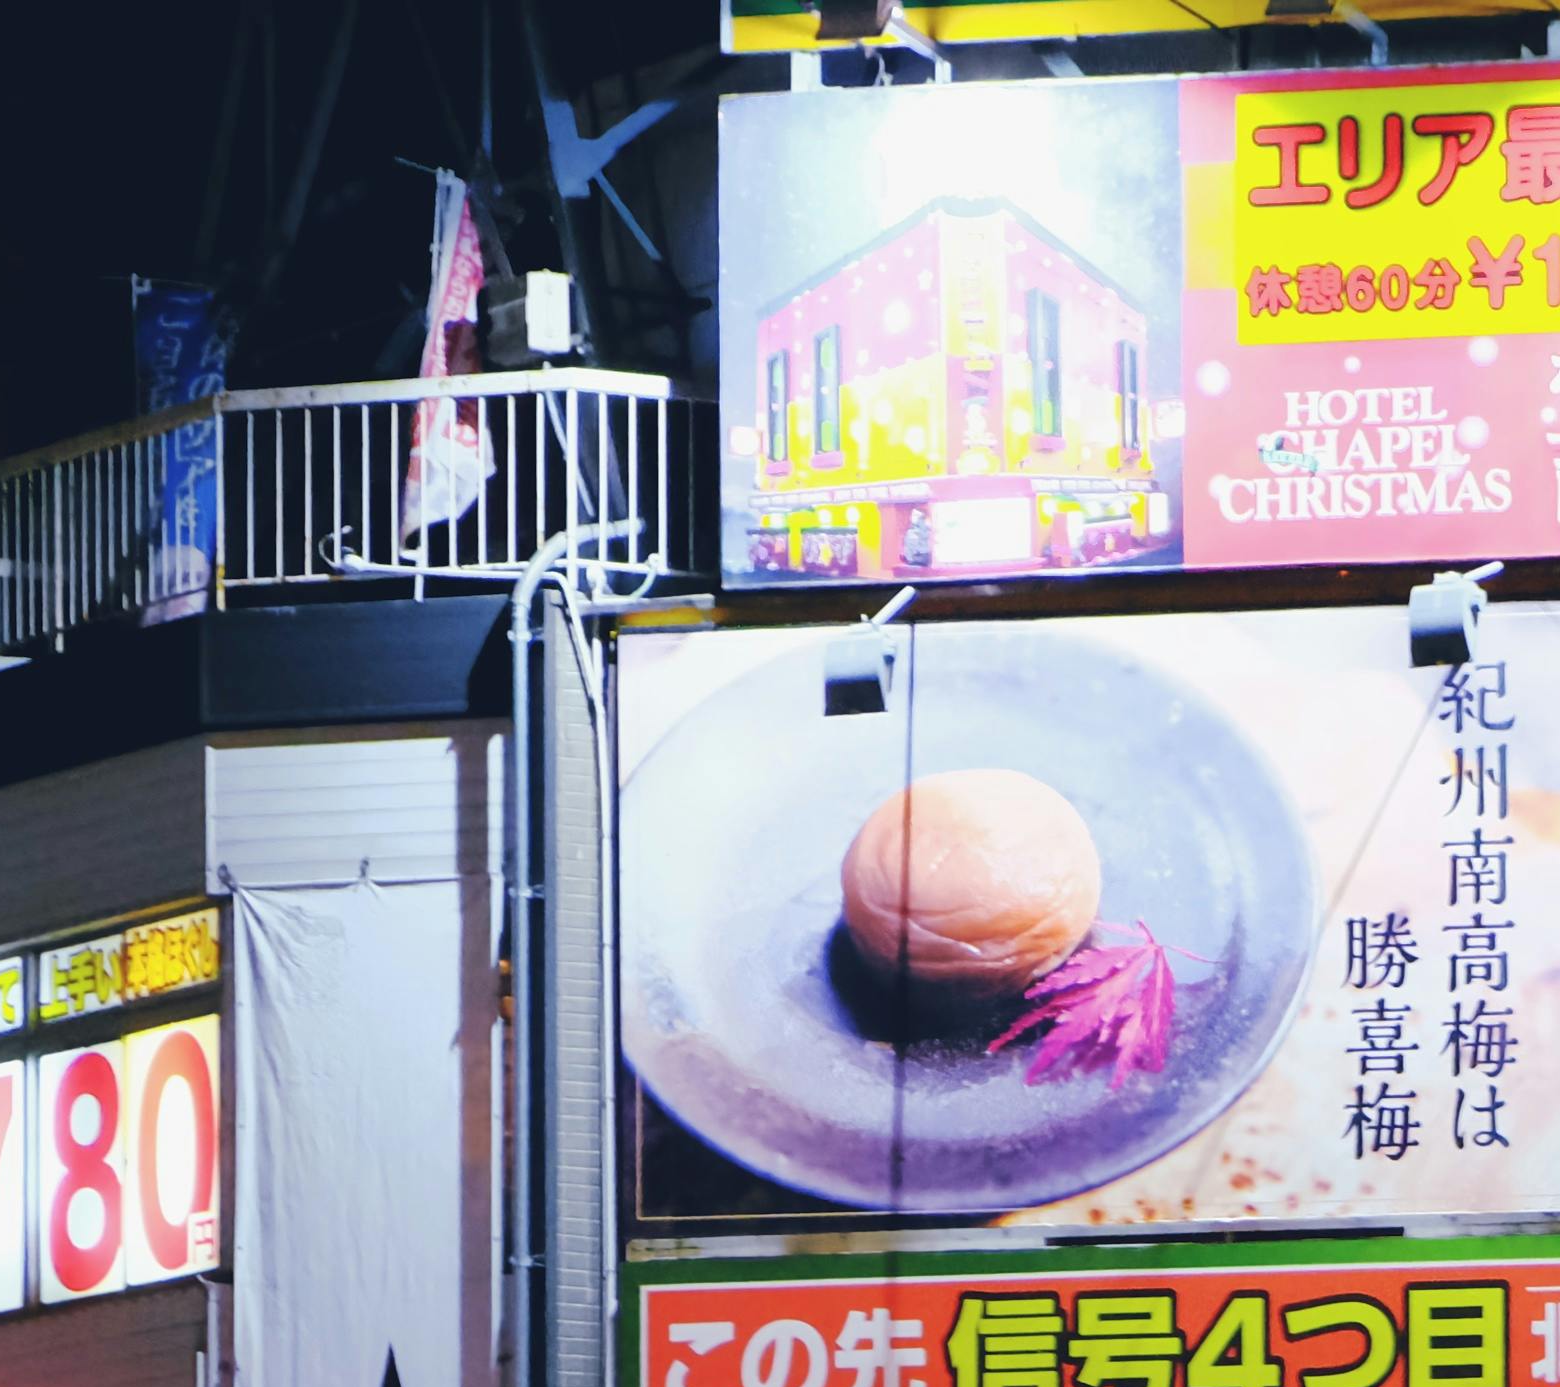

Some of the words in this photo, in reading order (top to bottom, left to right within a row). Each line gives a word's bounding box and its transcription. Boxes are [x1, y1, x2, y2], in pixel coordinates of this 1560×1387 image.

[1283, 386, 1446, 427] HOTEL
[1212, 466, 1513, 521] CHRISTMAS
[1438, 660, 1519, 1152] 紀州南高梅は
[1341, 912, 1421, 1163] 勝喜梅
